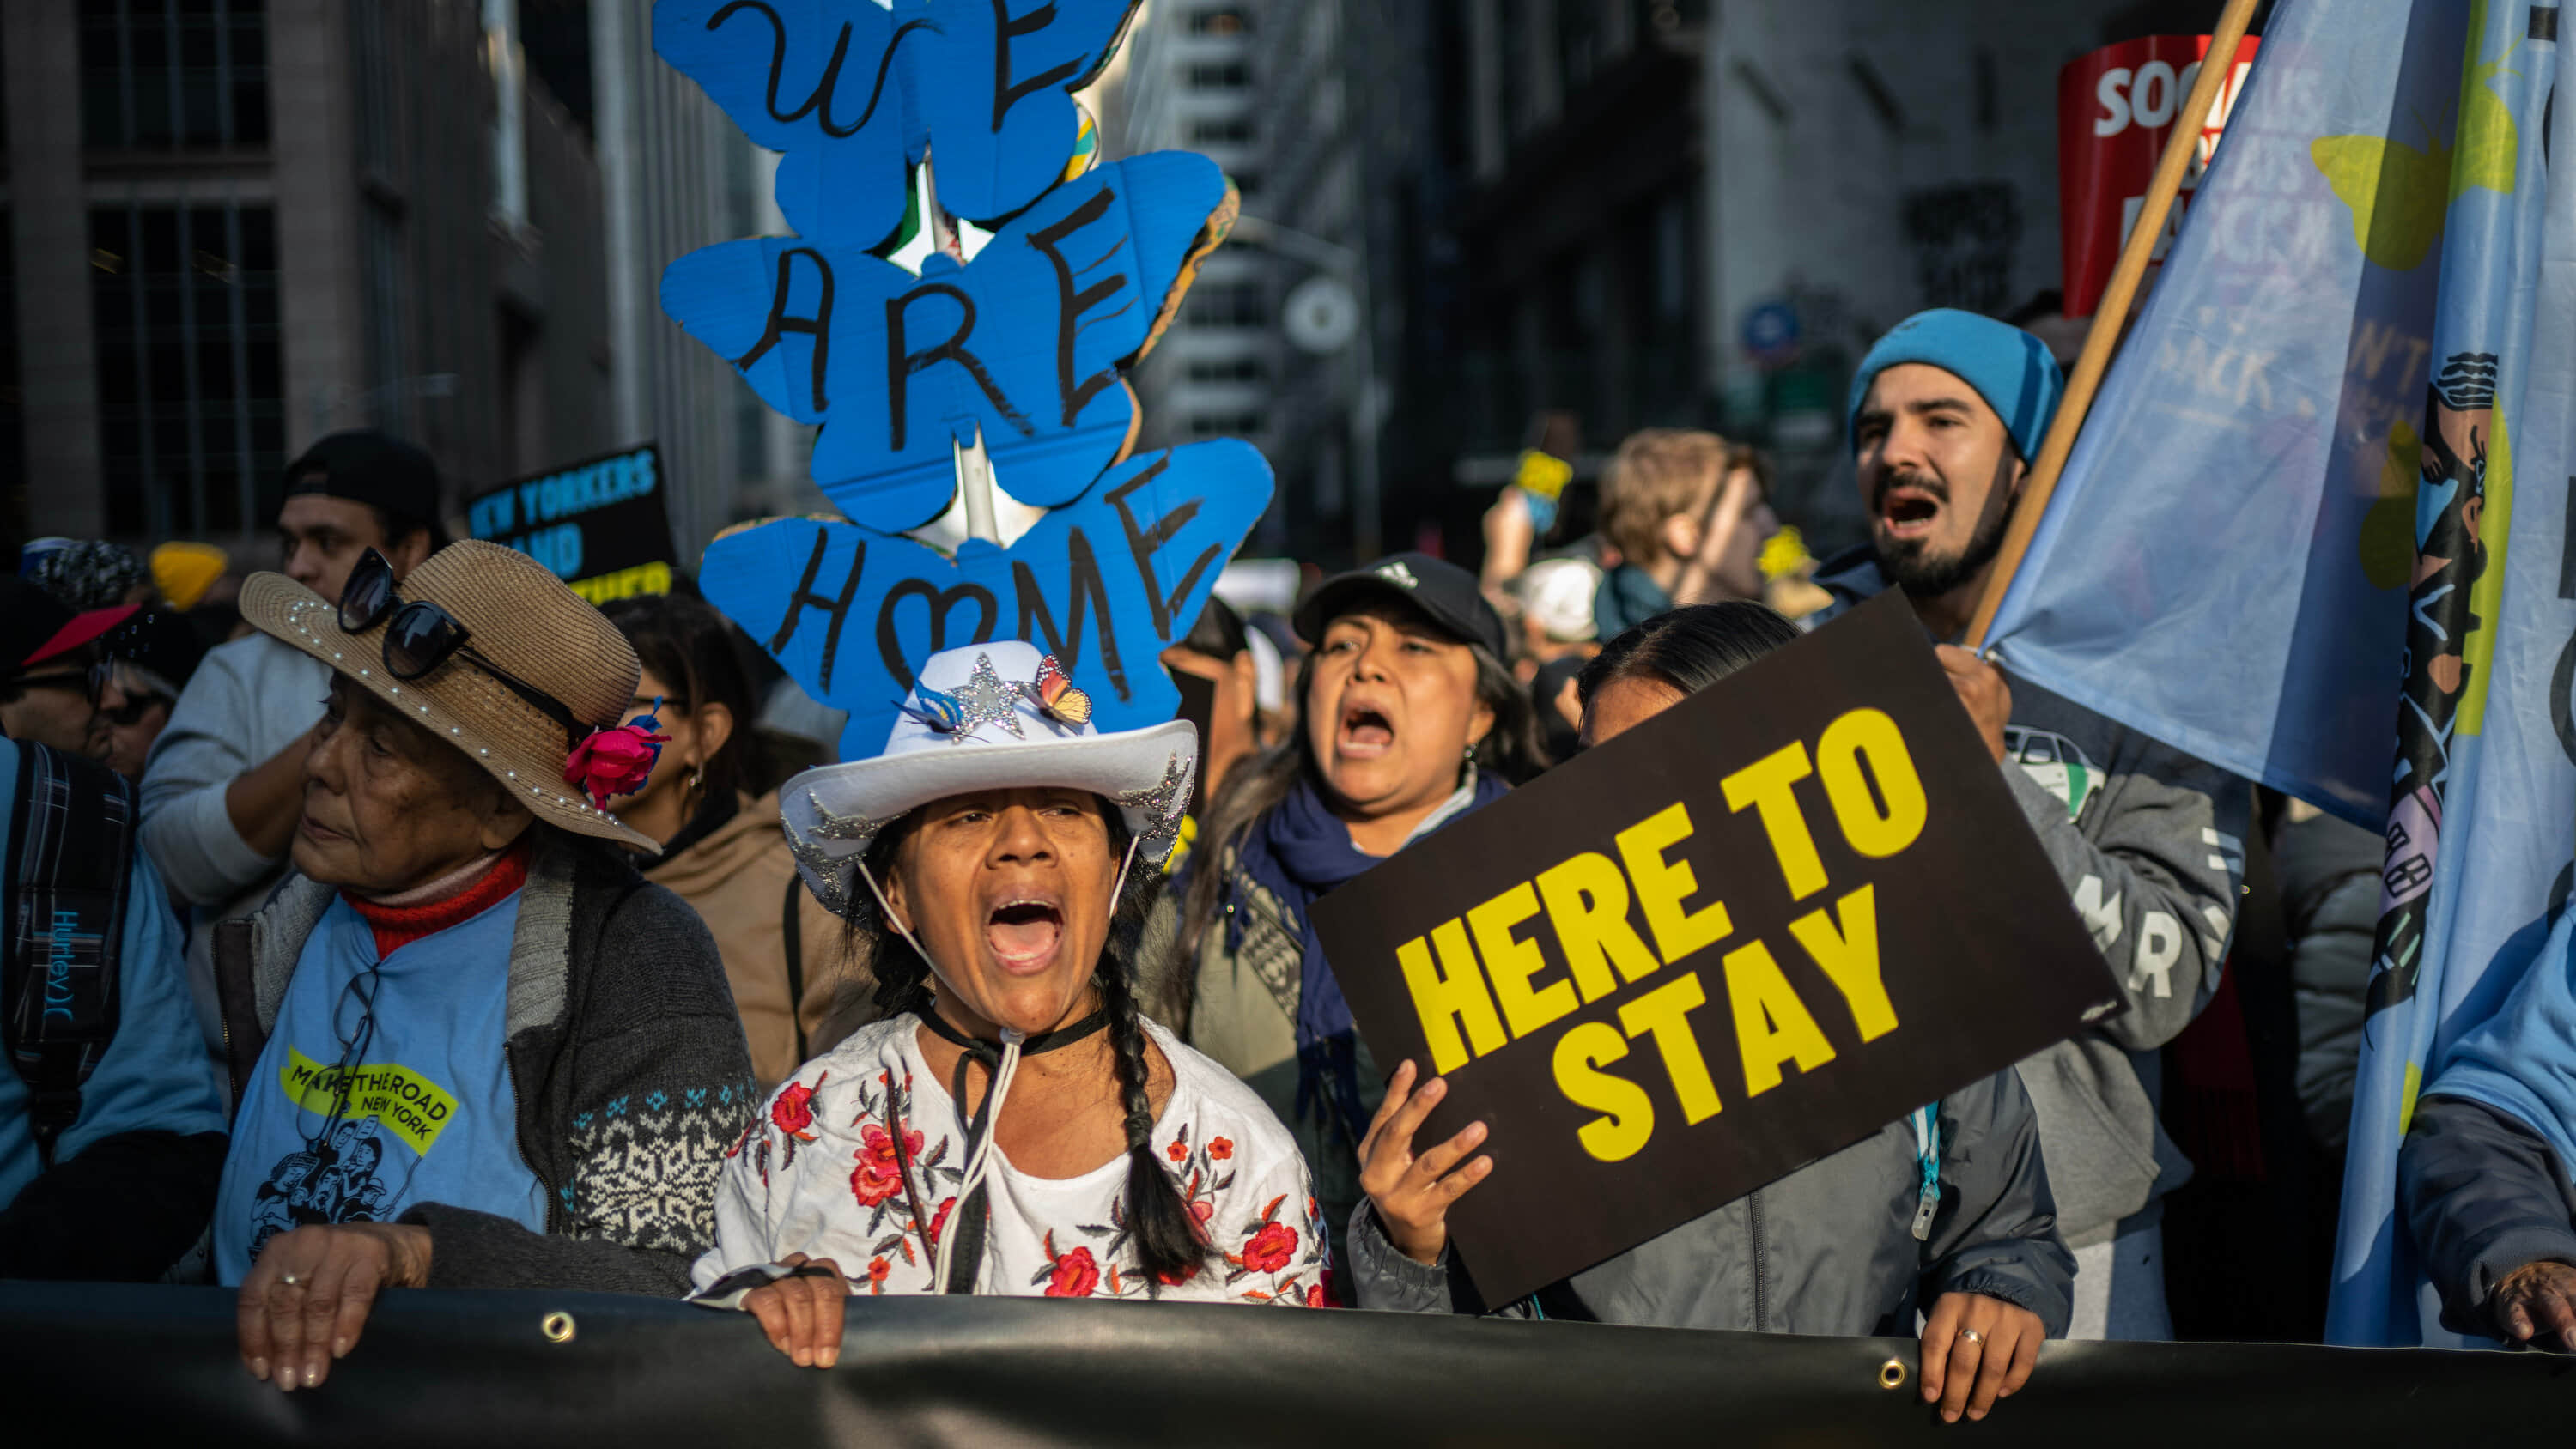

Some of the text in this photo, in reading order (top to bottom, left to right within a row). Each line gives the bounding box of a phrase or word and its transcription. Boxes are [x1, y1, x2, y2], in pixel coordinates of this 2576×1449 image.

[706, 0, 1089, 134] WE
[734, 183, 1139, 452] ARE
[519, 448, 656, 526] YORKERS
[1396, 706, 1928, 1076] HERE TO
[1552, 882, 1899, 1163] STAY
[290, 1064, 447, 1121] MAKE THE ROAD
[361, 1096, 434, 1141] NEW YORK
